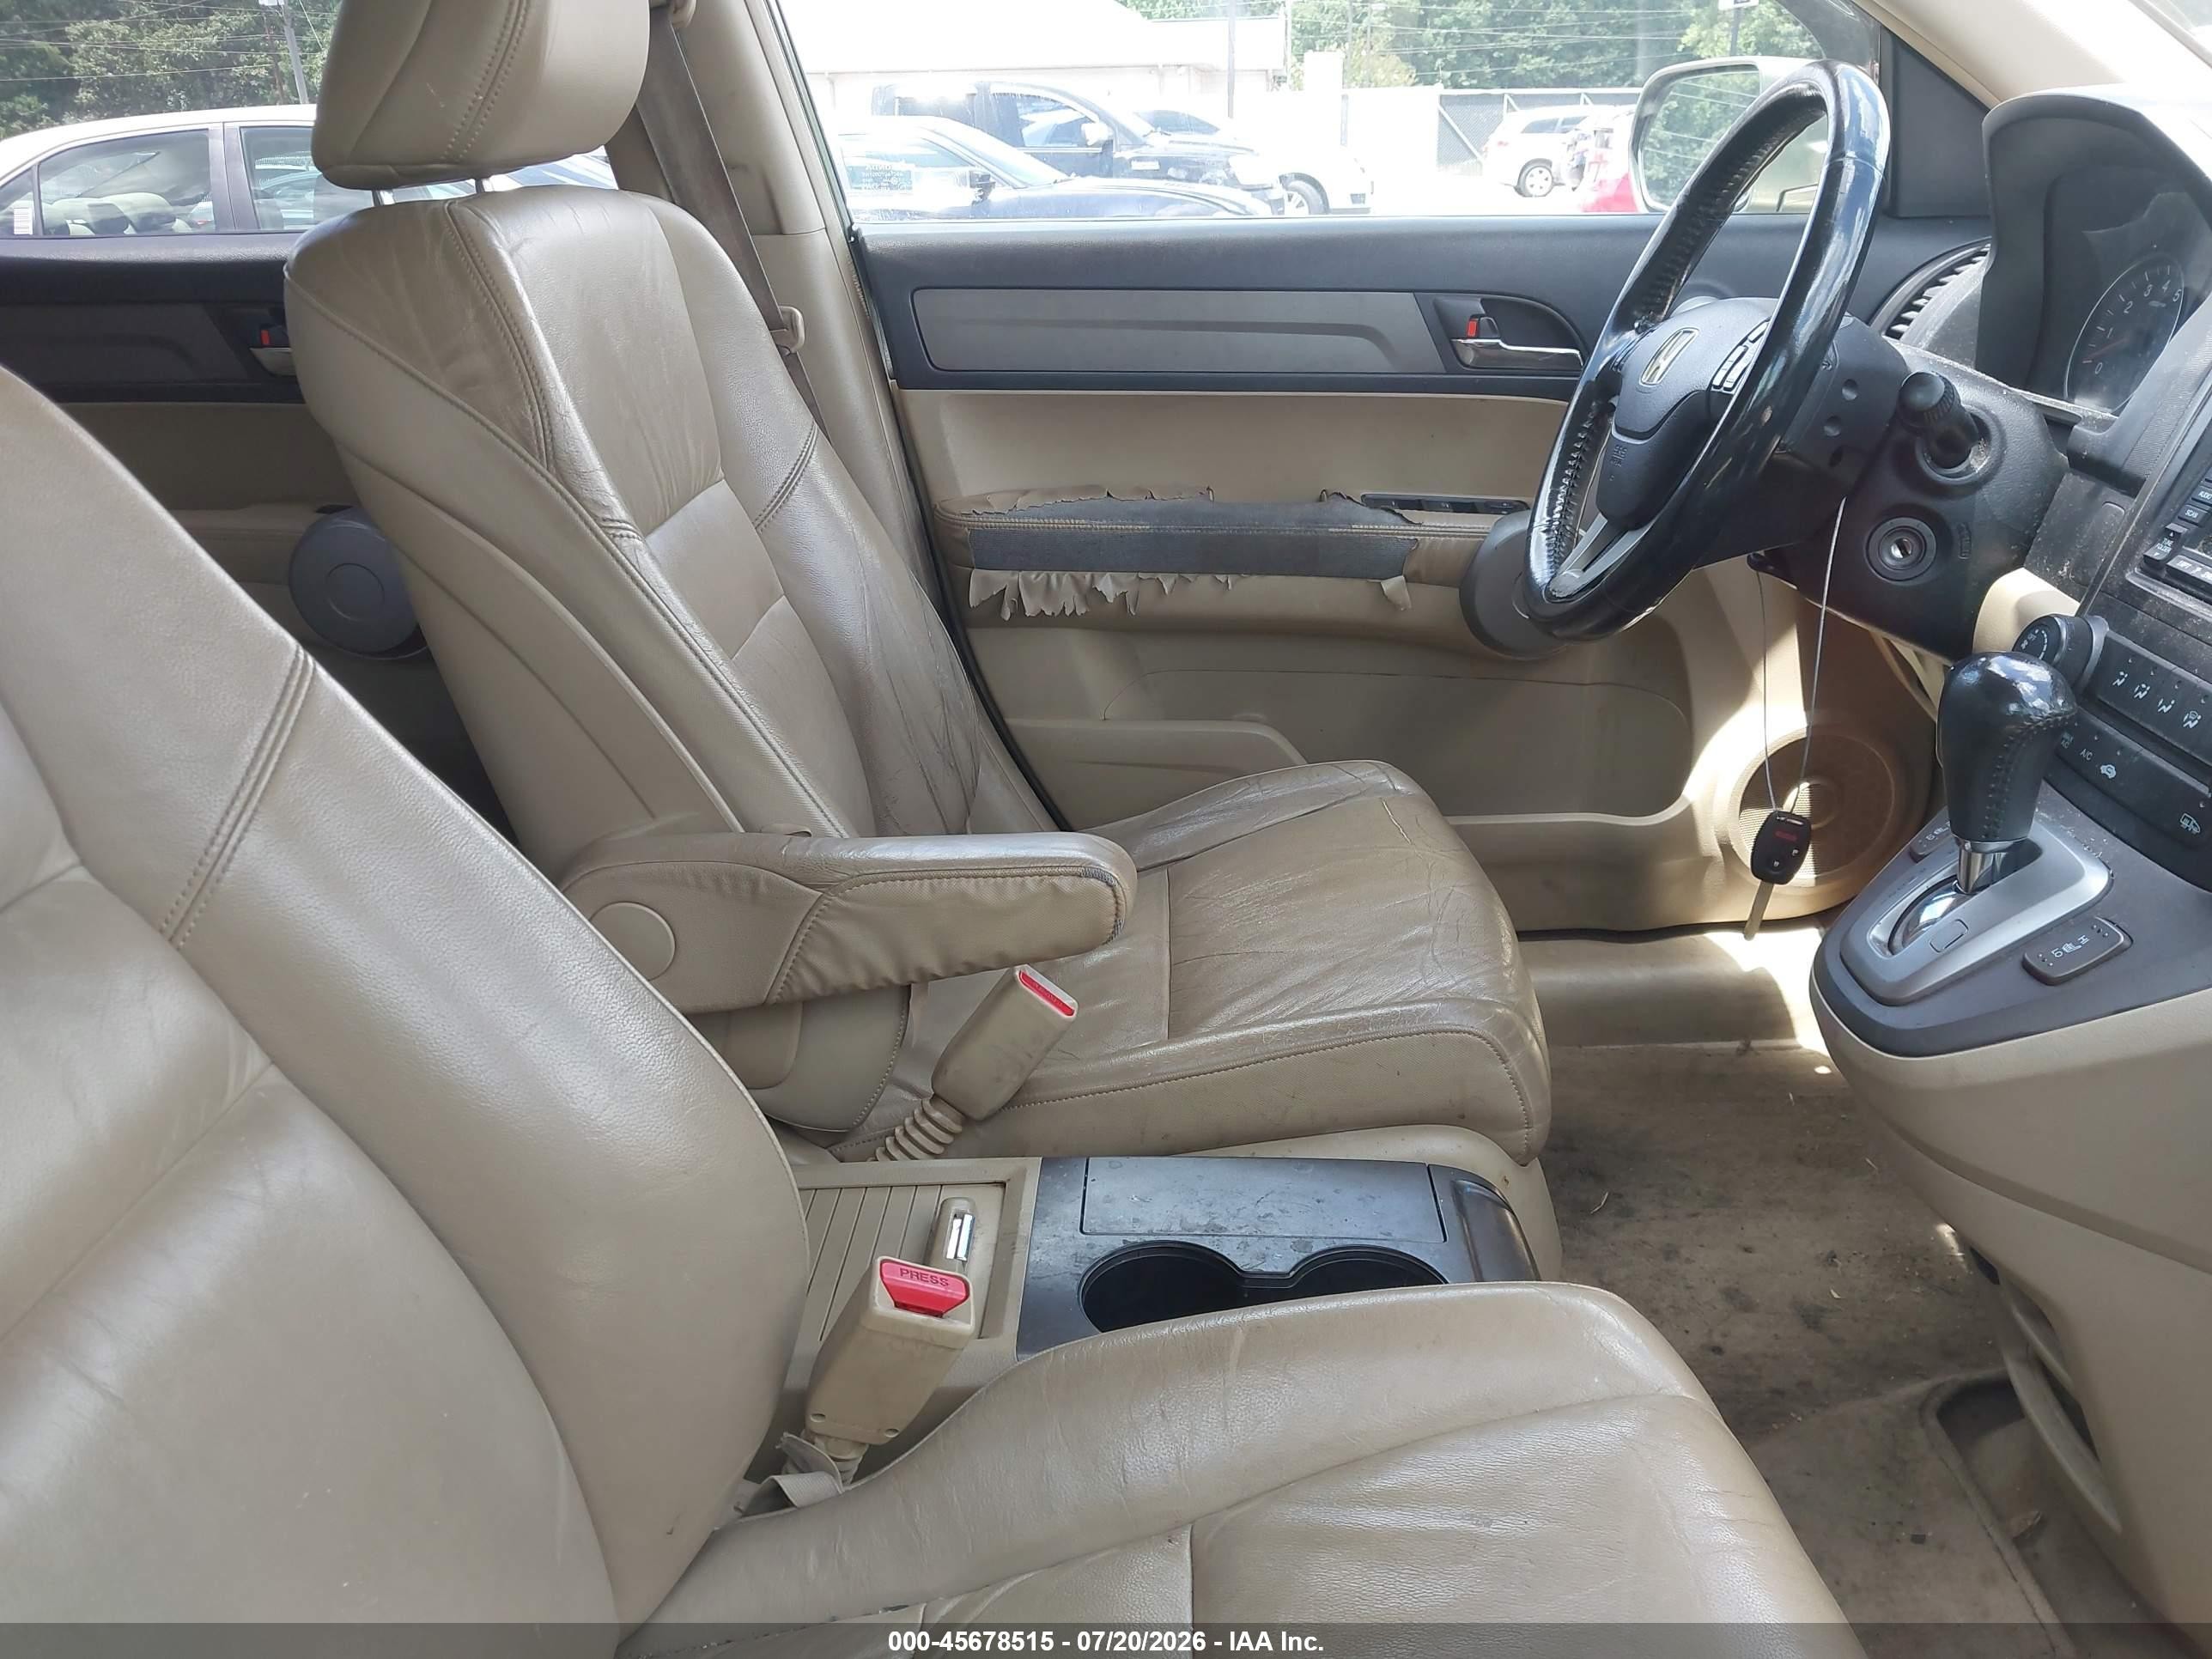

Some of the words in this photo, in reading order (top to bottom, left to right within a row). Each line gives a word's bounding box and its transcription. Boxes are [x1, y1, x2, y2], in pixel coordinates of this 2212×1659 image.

[2143, 284, 2153, 297] 3
[2162, 280, 2171, 293] 4
[2172, 289, 2182, 302] 5
[2124, 301, 2133, 314] 2
[2106, 327, 2113, 338] 1
[2094, 362, 2103, 375] 0
[899, 1267, 950, 1287] PRESS
